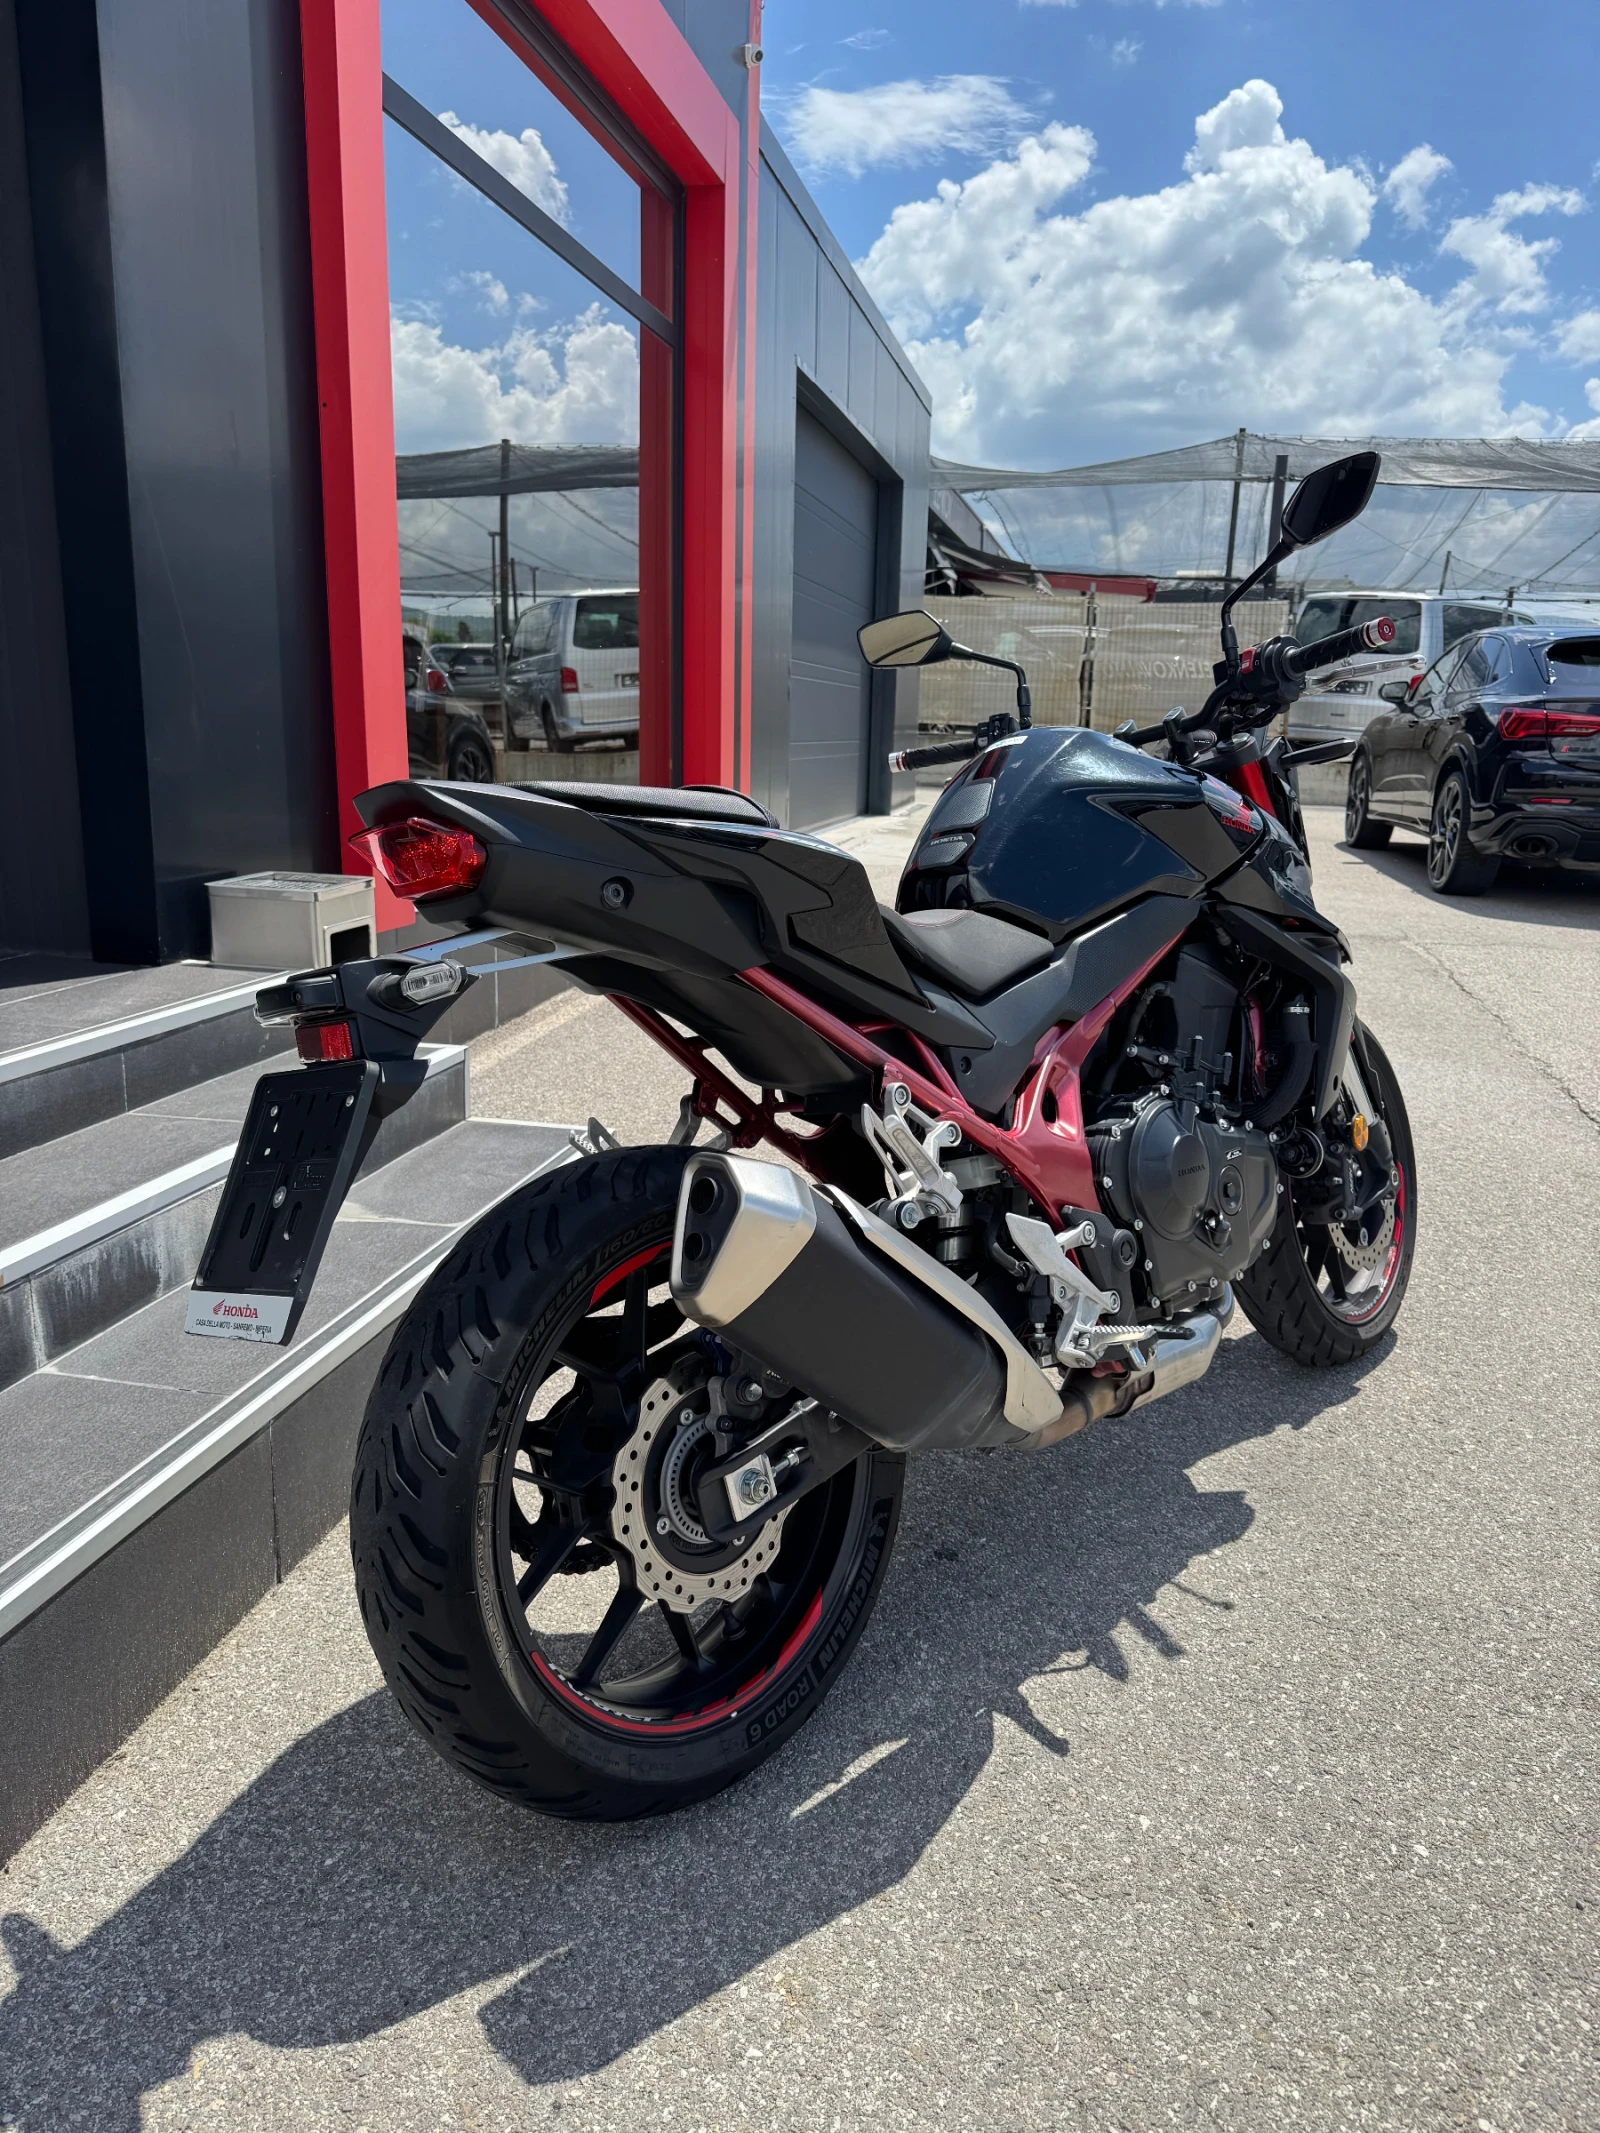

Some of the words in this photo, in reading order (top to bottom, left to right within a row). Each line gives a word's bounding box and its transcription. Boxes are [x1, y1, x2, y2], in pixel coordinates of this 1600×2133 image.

[1222, 815, 1256, 835] HONDA
[1177, 1163, 1206, 1177] HONDA
[222, 1305, 259, 1319] HONDA
[195, 1318, 206, 1326] CASA
[205, 1319, 219, 1328] DELLA
[219, 1321, 231, 1330] MOTO
[233, 1322, 254, 1332] SANREMO
[504, 1263, 588, 1398] MICHELIN
[818, 1543, 880, 1671] MICHELIN
[765, 1679, 809, 1728] ROAD
[750, 1723, 762, 1741] 6
